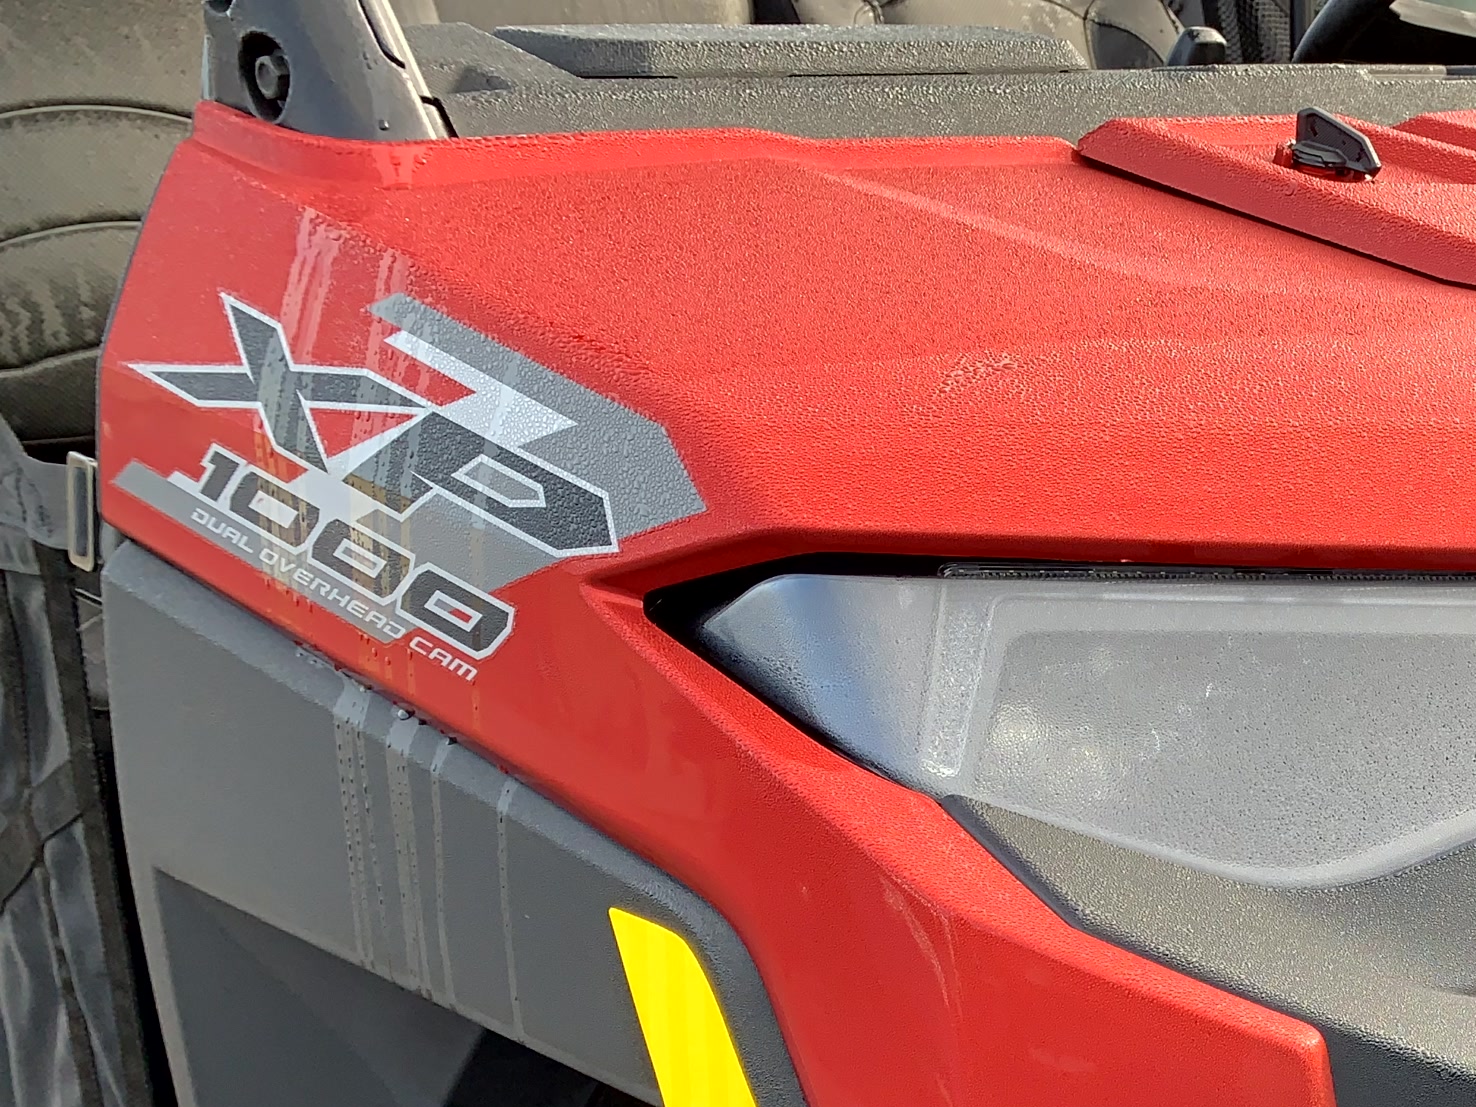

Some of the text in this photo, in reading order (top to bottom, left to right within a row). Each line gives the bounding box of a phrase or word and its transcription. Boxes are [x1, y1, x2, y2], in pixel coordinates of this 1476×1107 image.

[121, 290, 619, 557] XP
[190, 507, 478, 681] DUAL OVERHEAD CAM
[193, 442, 516, 660] 1000
